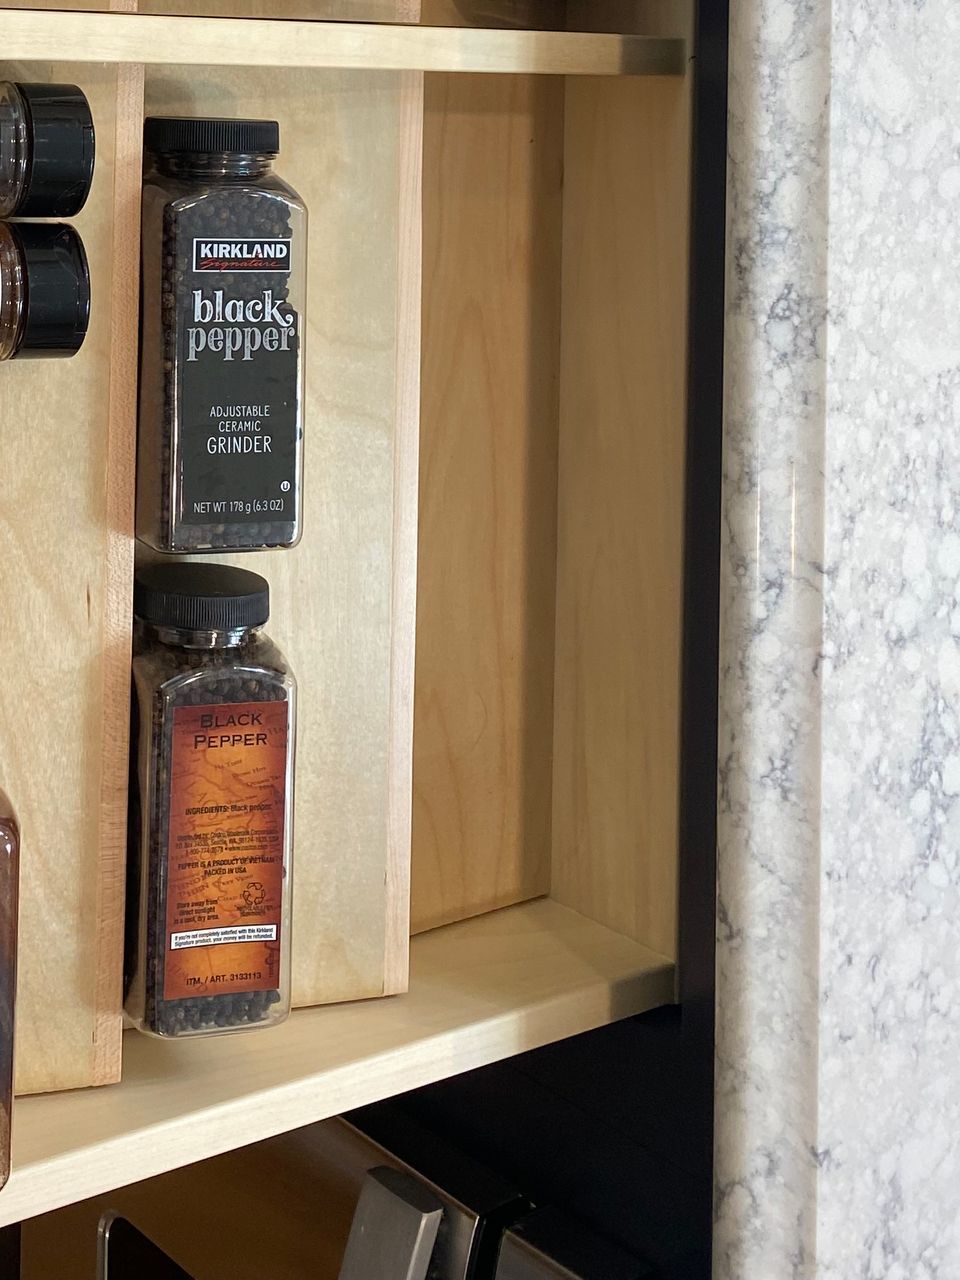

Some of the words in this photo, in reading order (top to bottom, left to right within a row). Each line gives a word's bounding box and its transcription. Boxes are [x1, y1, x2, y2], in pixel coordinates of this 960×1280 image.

[200, 243, 287, 258] KIRKLAND
[192, 290, 294, 326] black
[187, 325, 295, 362] pepper
[210, 406, 270, 416] ADJUSTABLE
[219, 421, 261, 432] CERAMIC
[207, 437, 271, 453] GRINDER
[193, 502, 211, 513] NET
[212, 502, 227, 512] WT
[229, 502, 243, 512] 178
[245, 504, 251, 515] g
[252, 501, 268, 512] (6.3
[269, 501, 284, 511] OZ)
[200, 713, 262, 728] BLACK
[193, 733, 267, 749] PEPPER
[210, 974, 228, 985] ART.
